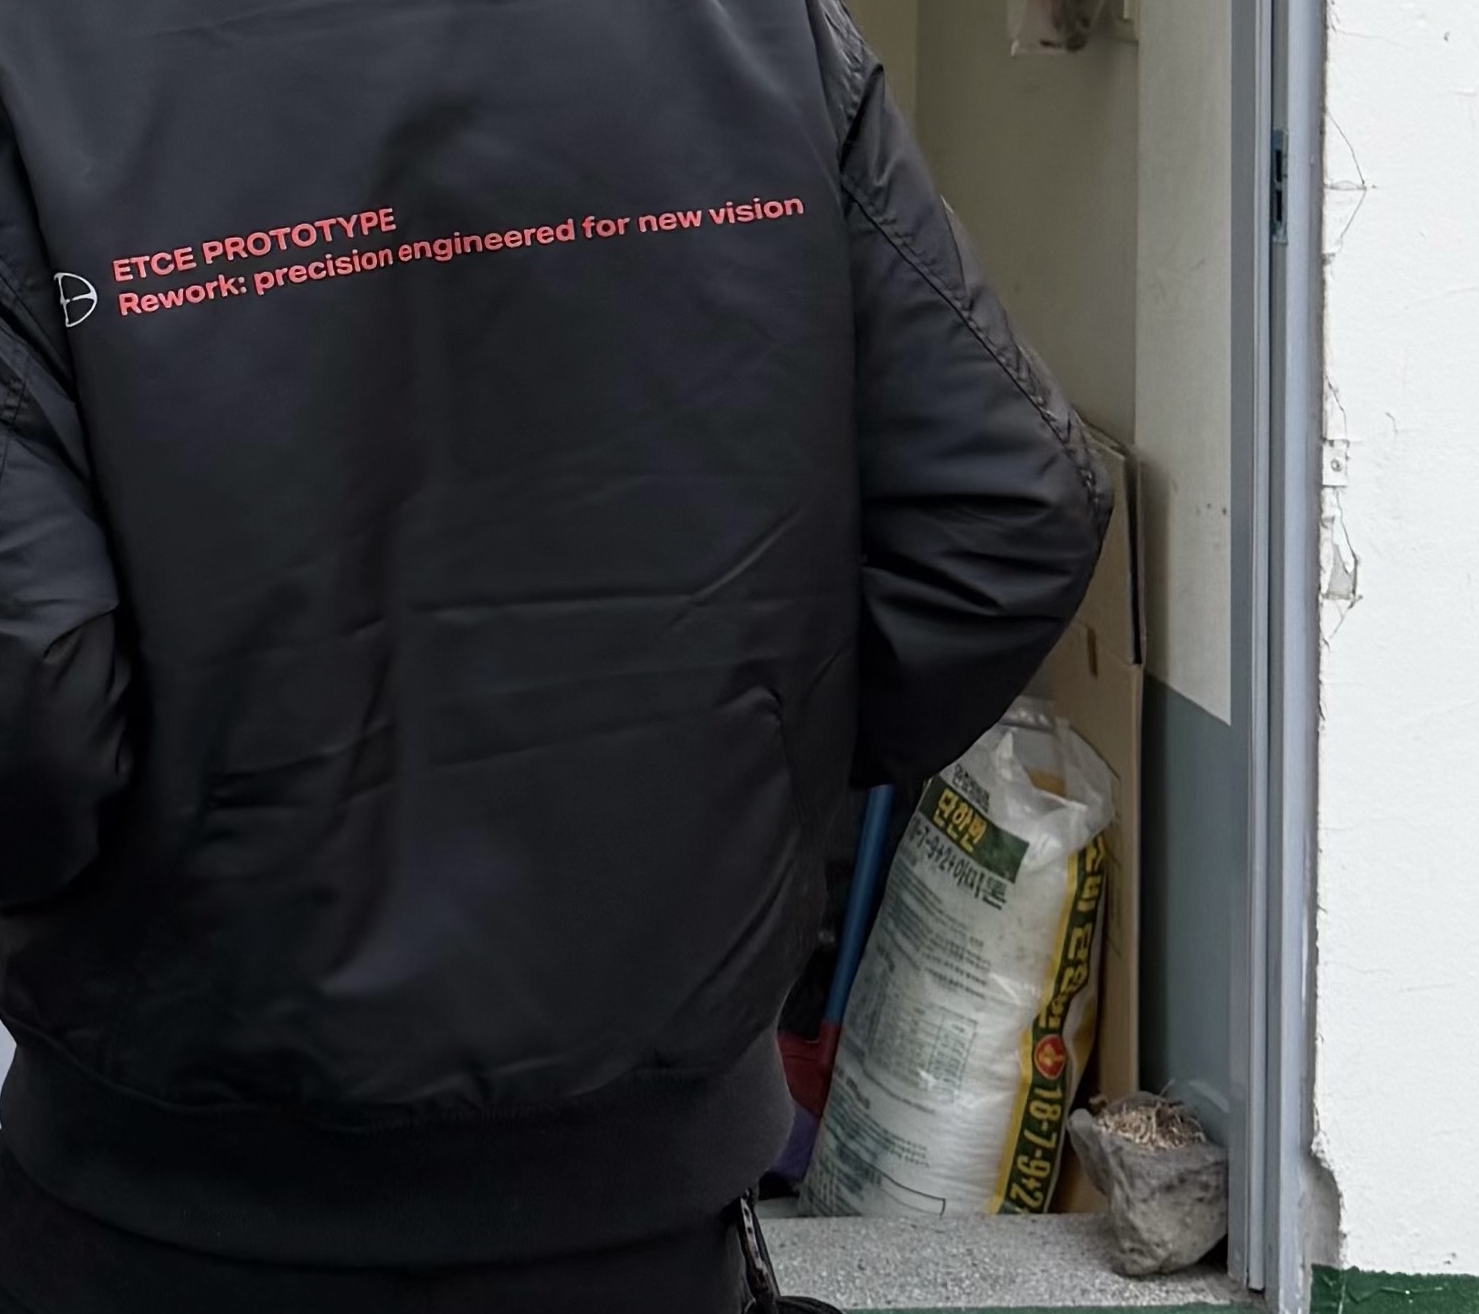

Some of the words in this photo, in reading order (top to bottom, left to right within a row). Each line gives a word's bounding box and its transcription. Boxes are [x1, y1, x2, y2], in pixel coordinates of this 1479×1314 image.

[112, 246, 197, 282] ETCE
[202, 208, 397, 263] PROTOTYPE
[118, 275, 247, 315] Rework:
[253, 248, 393, 294] precision
[397, 219, 575, 262] engineered
[581, 216, 630, 238] for
[637, 210, 702, 233] new
[708, 197, 803, 224] vision
[932, 787, 988, 853] 단한번
